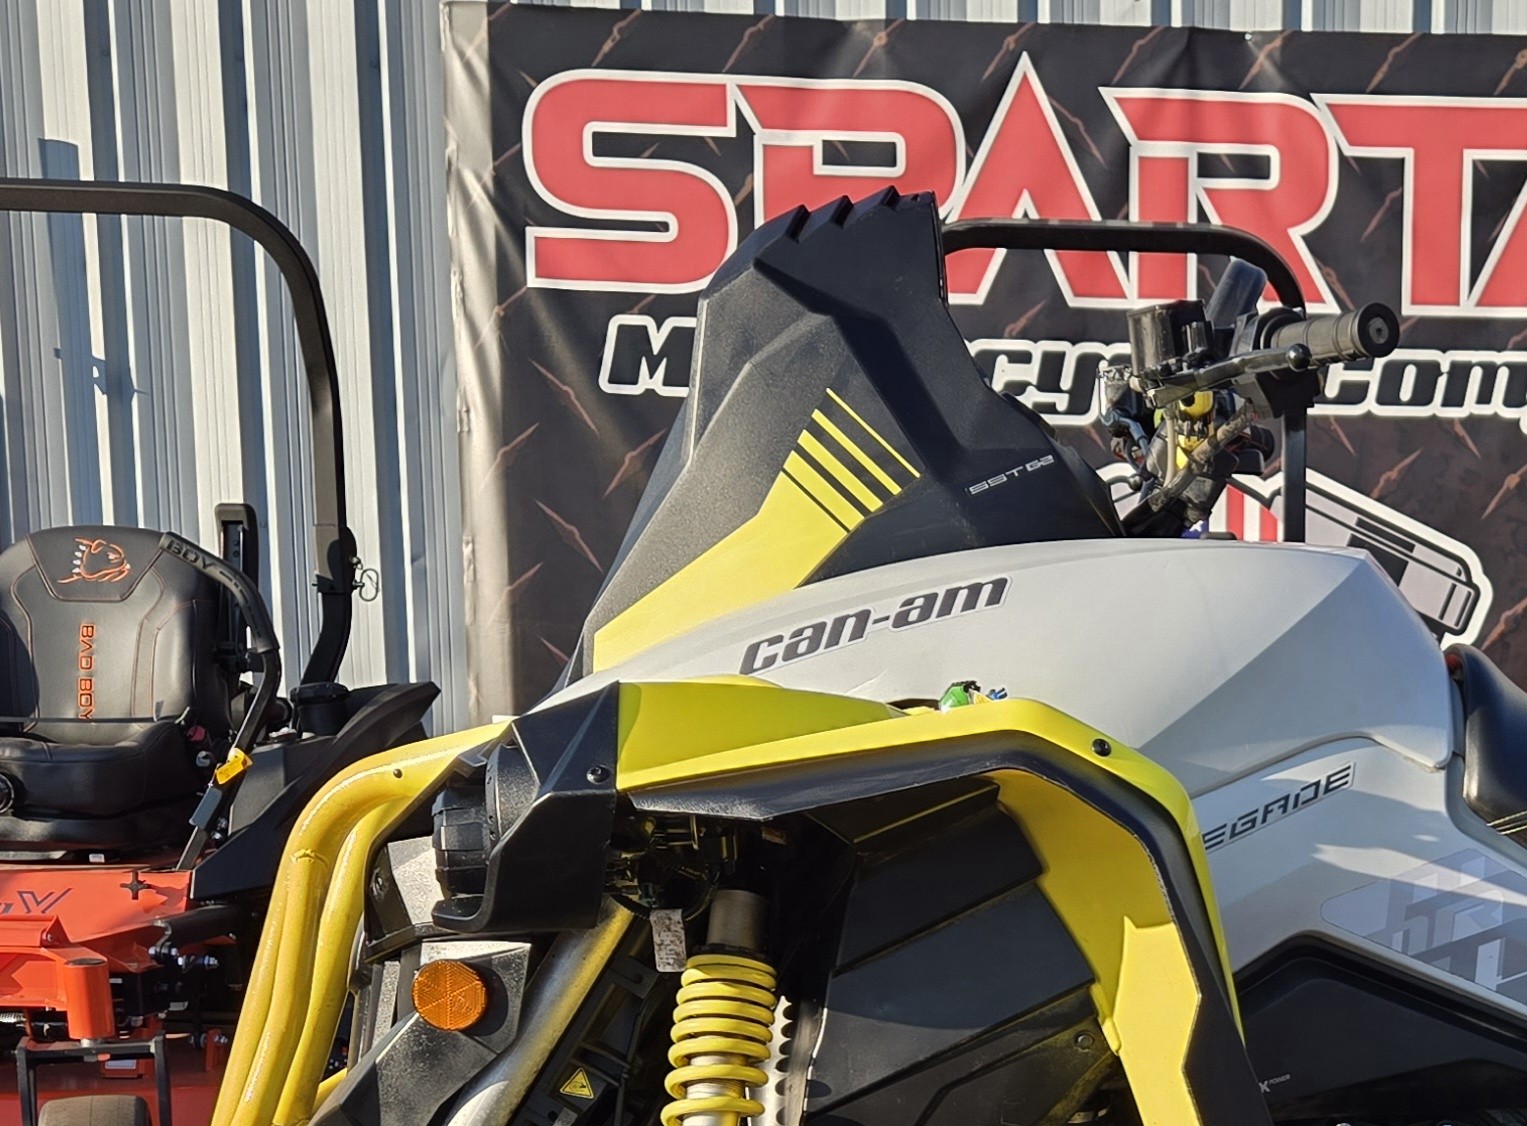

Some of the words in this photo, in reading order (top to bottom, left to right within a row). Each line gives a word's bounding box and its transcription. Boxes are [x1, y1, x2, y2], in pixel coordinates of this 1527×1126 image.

[78, 623, 96, 671] BAD
[741, 577, 1010, 674] can-am
[1202, 765, 1351, 850] EGADE
